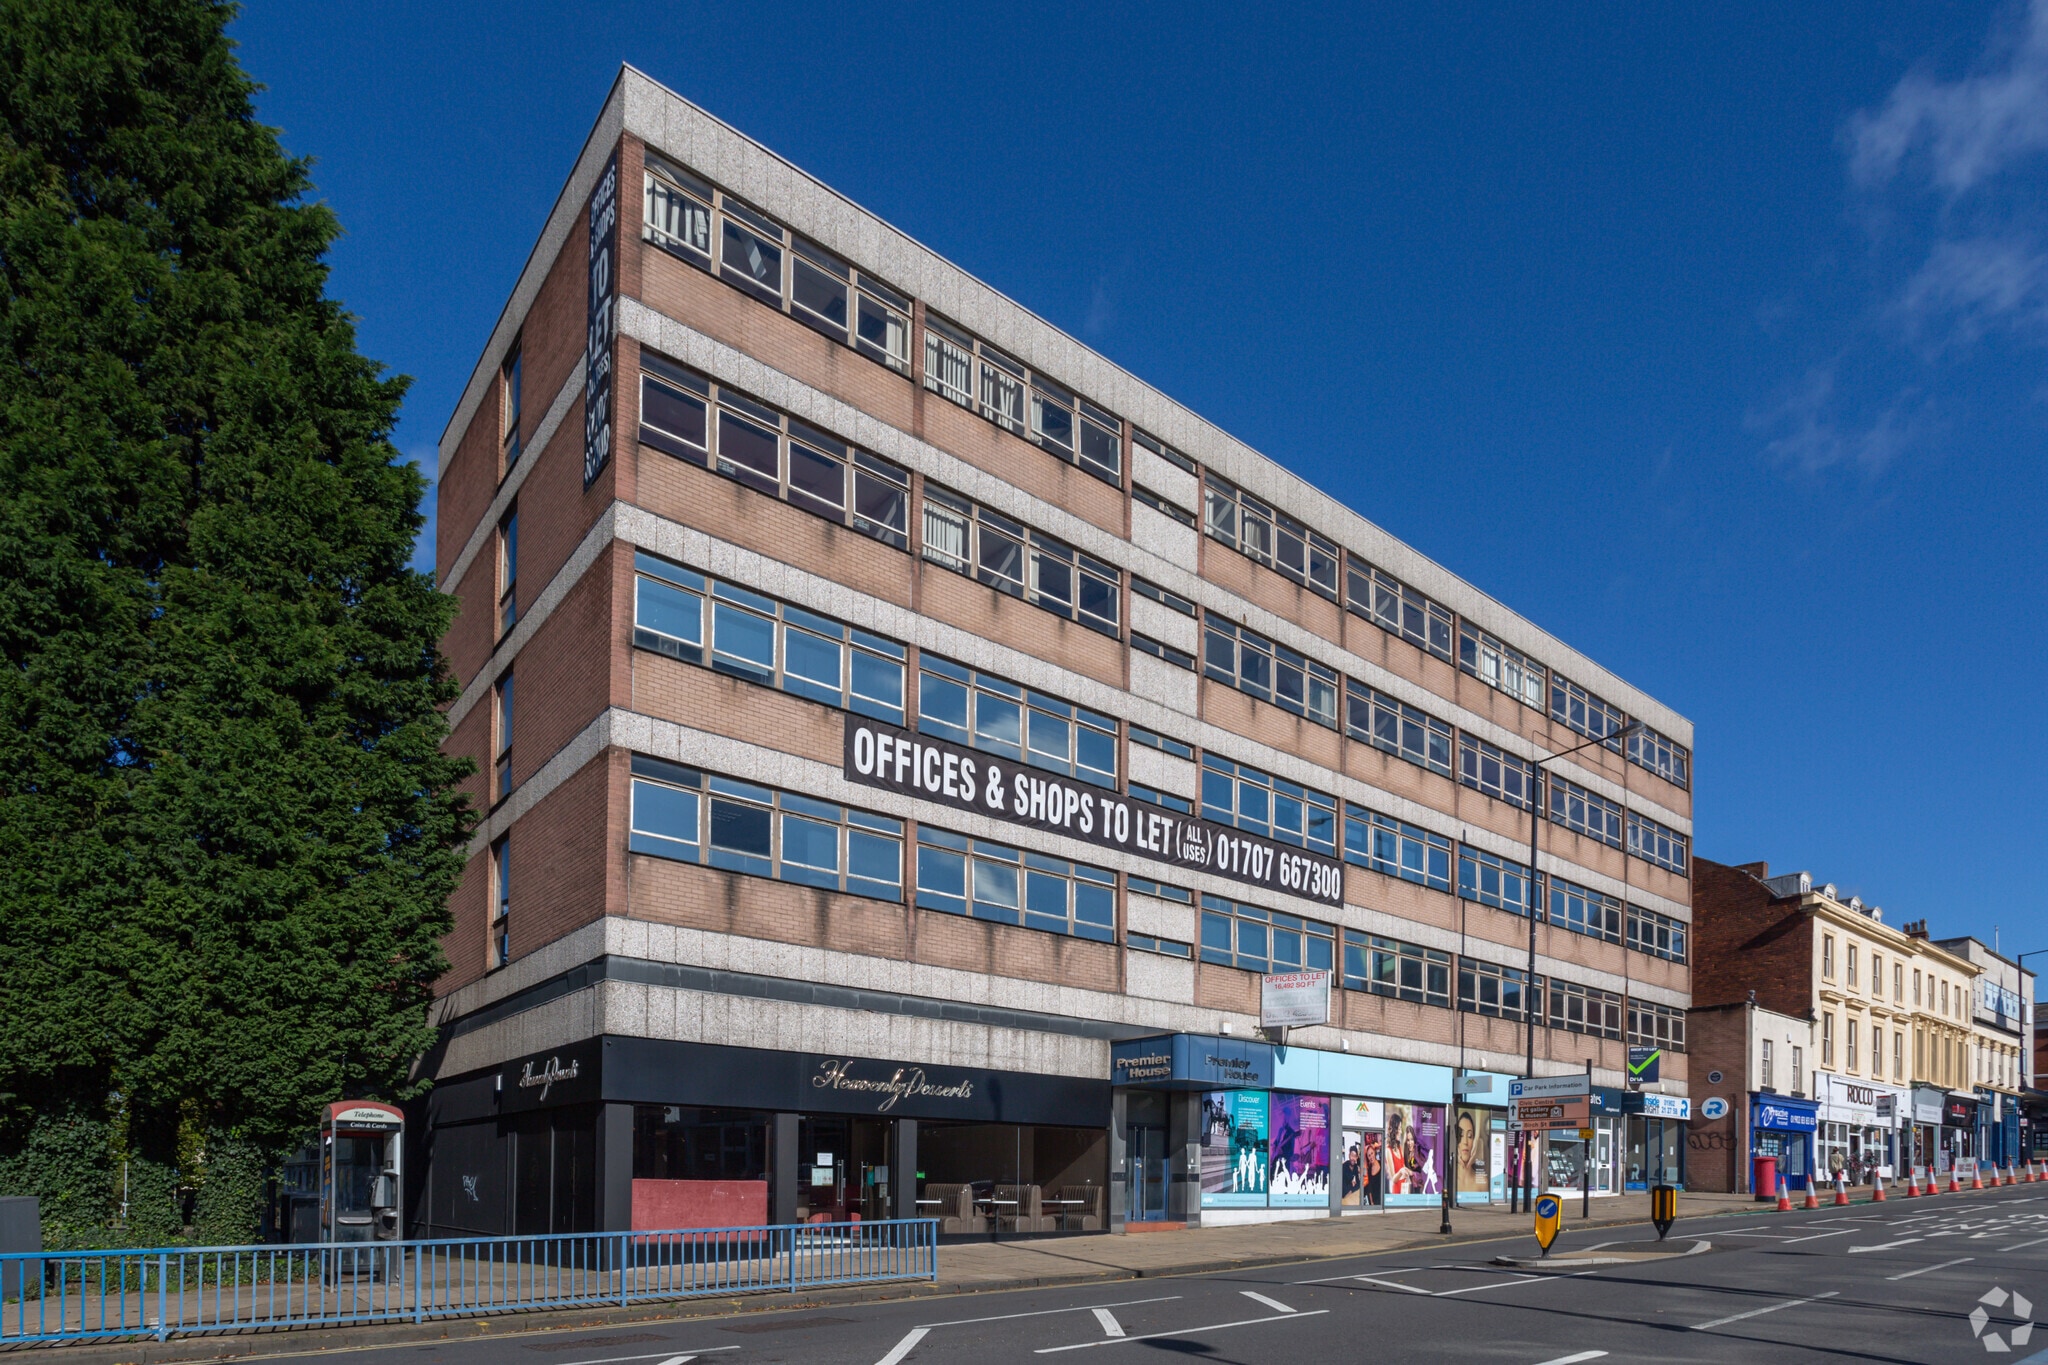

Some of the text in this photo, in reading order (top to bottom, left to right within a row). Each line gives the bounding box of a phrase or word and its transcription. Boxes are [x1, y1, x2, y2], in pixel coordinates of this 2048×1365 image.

[593, 248, 608, 309] TO
[854, 727, 976, 802] OFFICES
[985, 765, 1005, 810] &
[1014, 773, 1094, 833] SHOPS
[1101, 798, 1129, 843] TO
[1136, 809, 1173, 855] LET
[1217, 833, 1274, 881] 01707
[1279, 852, 1341, 900] 667300
[1265, 972, 1325, 984] OFFICES TO LET
[1274, 982, 1294, 990] 16,492
[1116, 1053, 1171, 1069] Premier
[1205, 1054, 1251, 1070] Premier
[1129, 1067, 1170, 1079] House
[1224, 1068, 1259, 1082] House
[812, 1059, 974, 1112] Heavenly Desserts
[1238, 1094, 1260, 1104] Discover
[1644, 1095, 1660, 1107] nside
[1847, 1085, 1873, 1106] ROCCO
[1300, 1099, 1316, 1109] Events
[1530, 1106, 1549, 1114] gallery
[354, 1111, 384, 1119] Telephone
[1422, 1110, 1432, 1119] Shop
